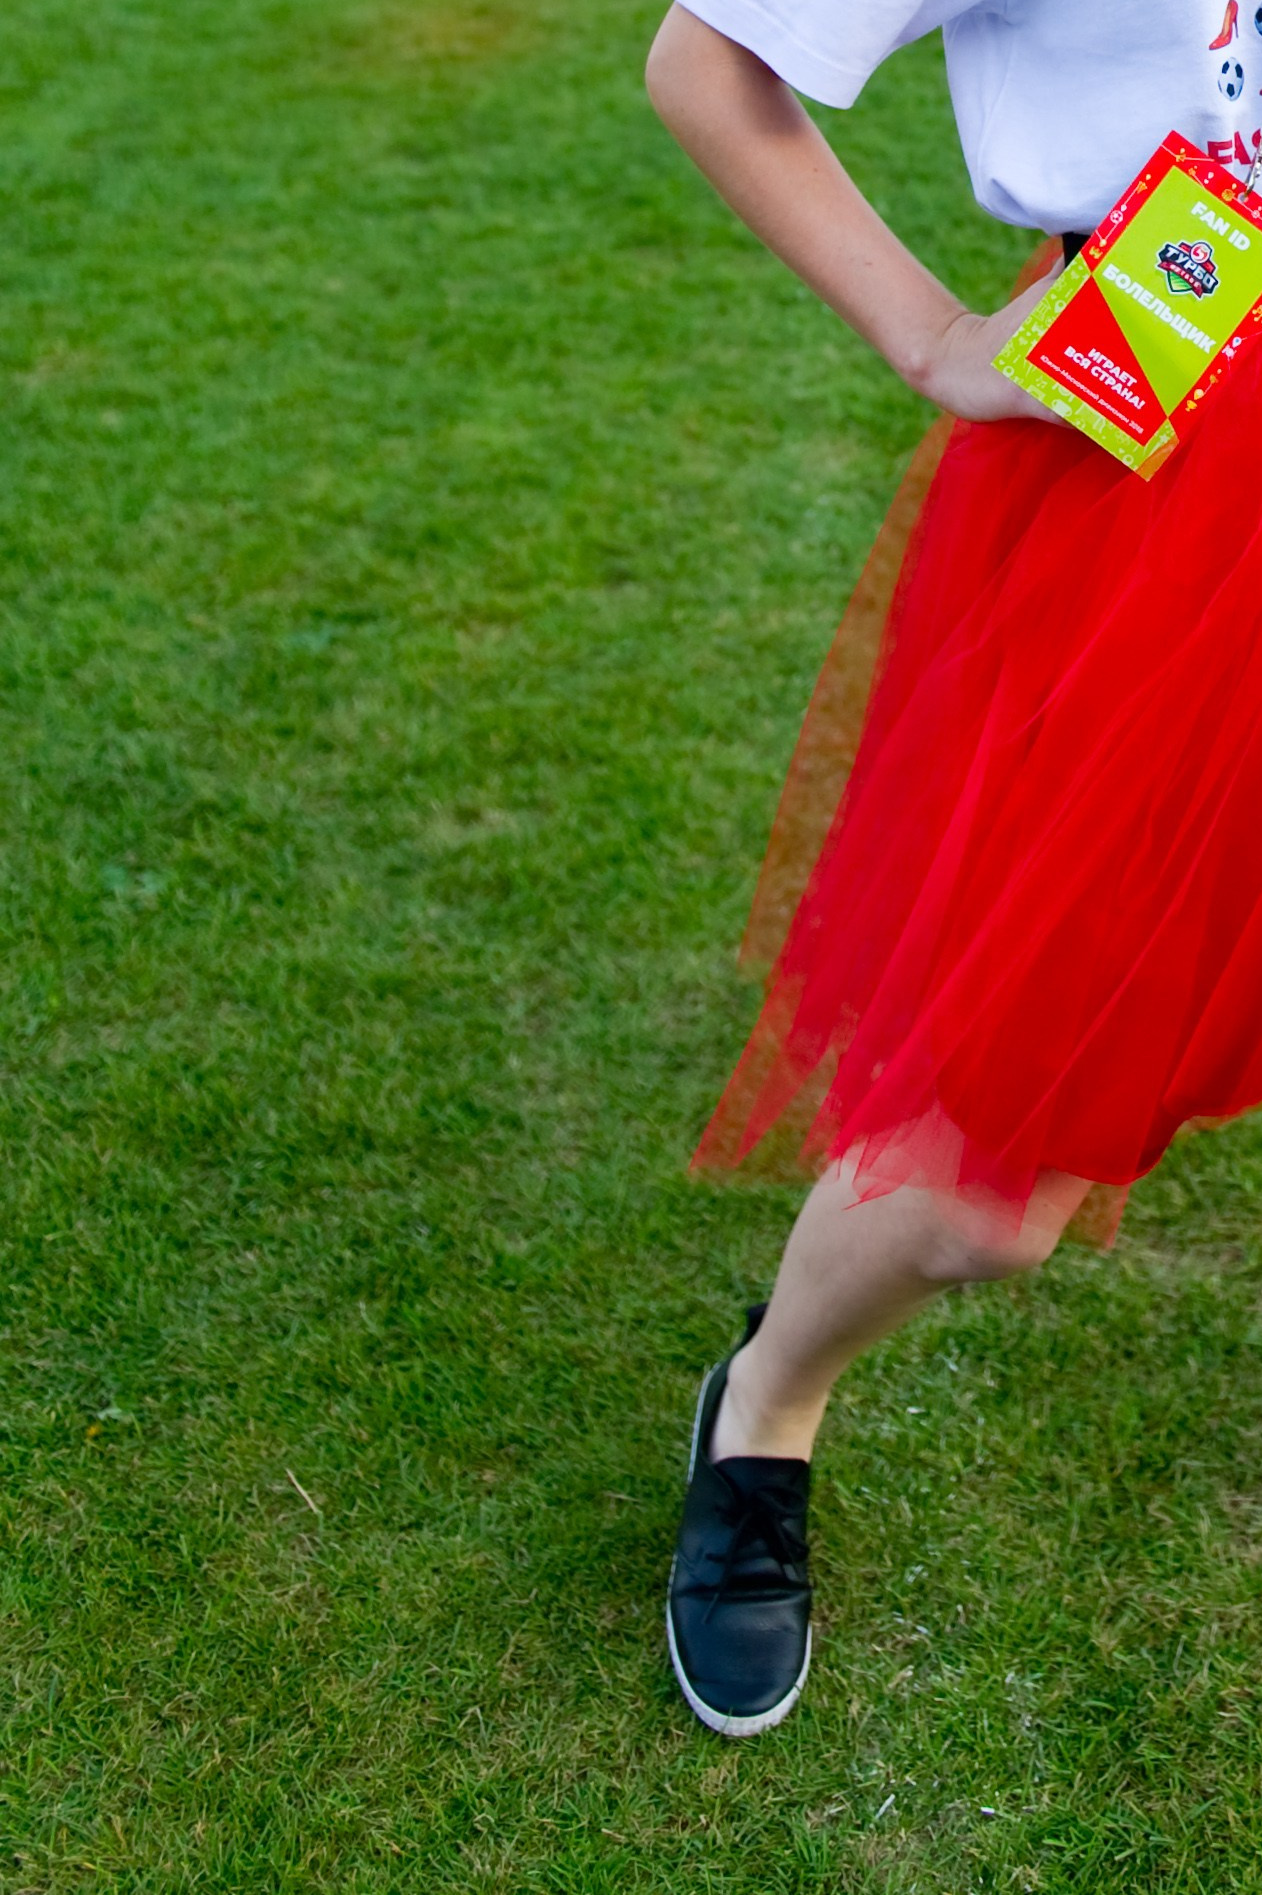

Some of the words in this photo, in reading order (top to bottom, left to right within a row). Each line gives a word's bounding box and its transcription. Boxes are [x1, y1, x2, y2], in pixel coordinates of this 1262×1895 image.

[1190, 201, 1231, 236] FAN
[1228, 229, 1251, 251] ID
[1166, 246, 1216, 289] ТУРБО
[1102, 263, 1217, 354] БОЛЕЛЬЩИК
[1064, 346, 1091, 369] ВСЯ
[1091, 366, 1146, 410] СТРАНА!
[1088, 348, 1137, 387] ИГРАЕТ
